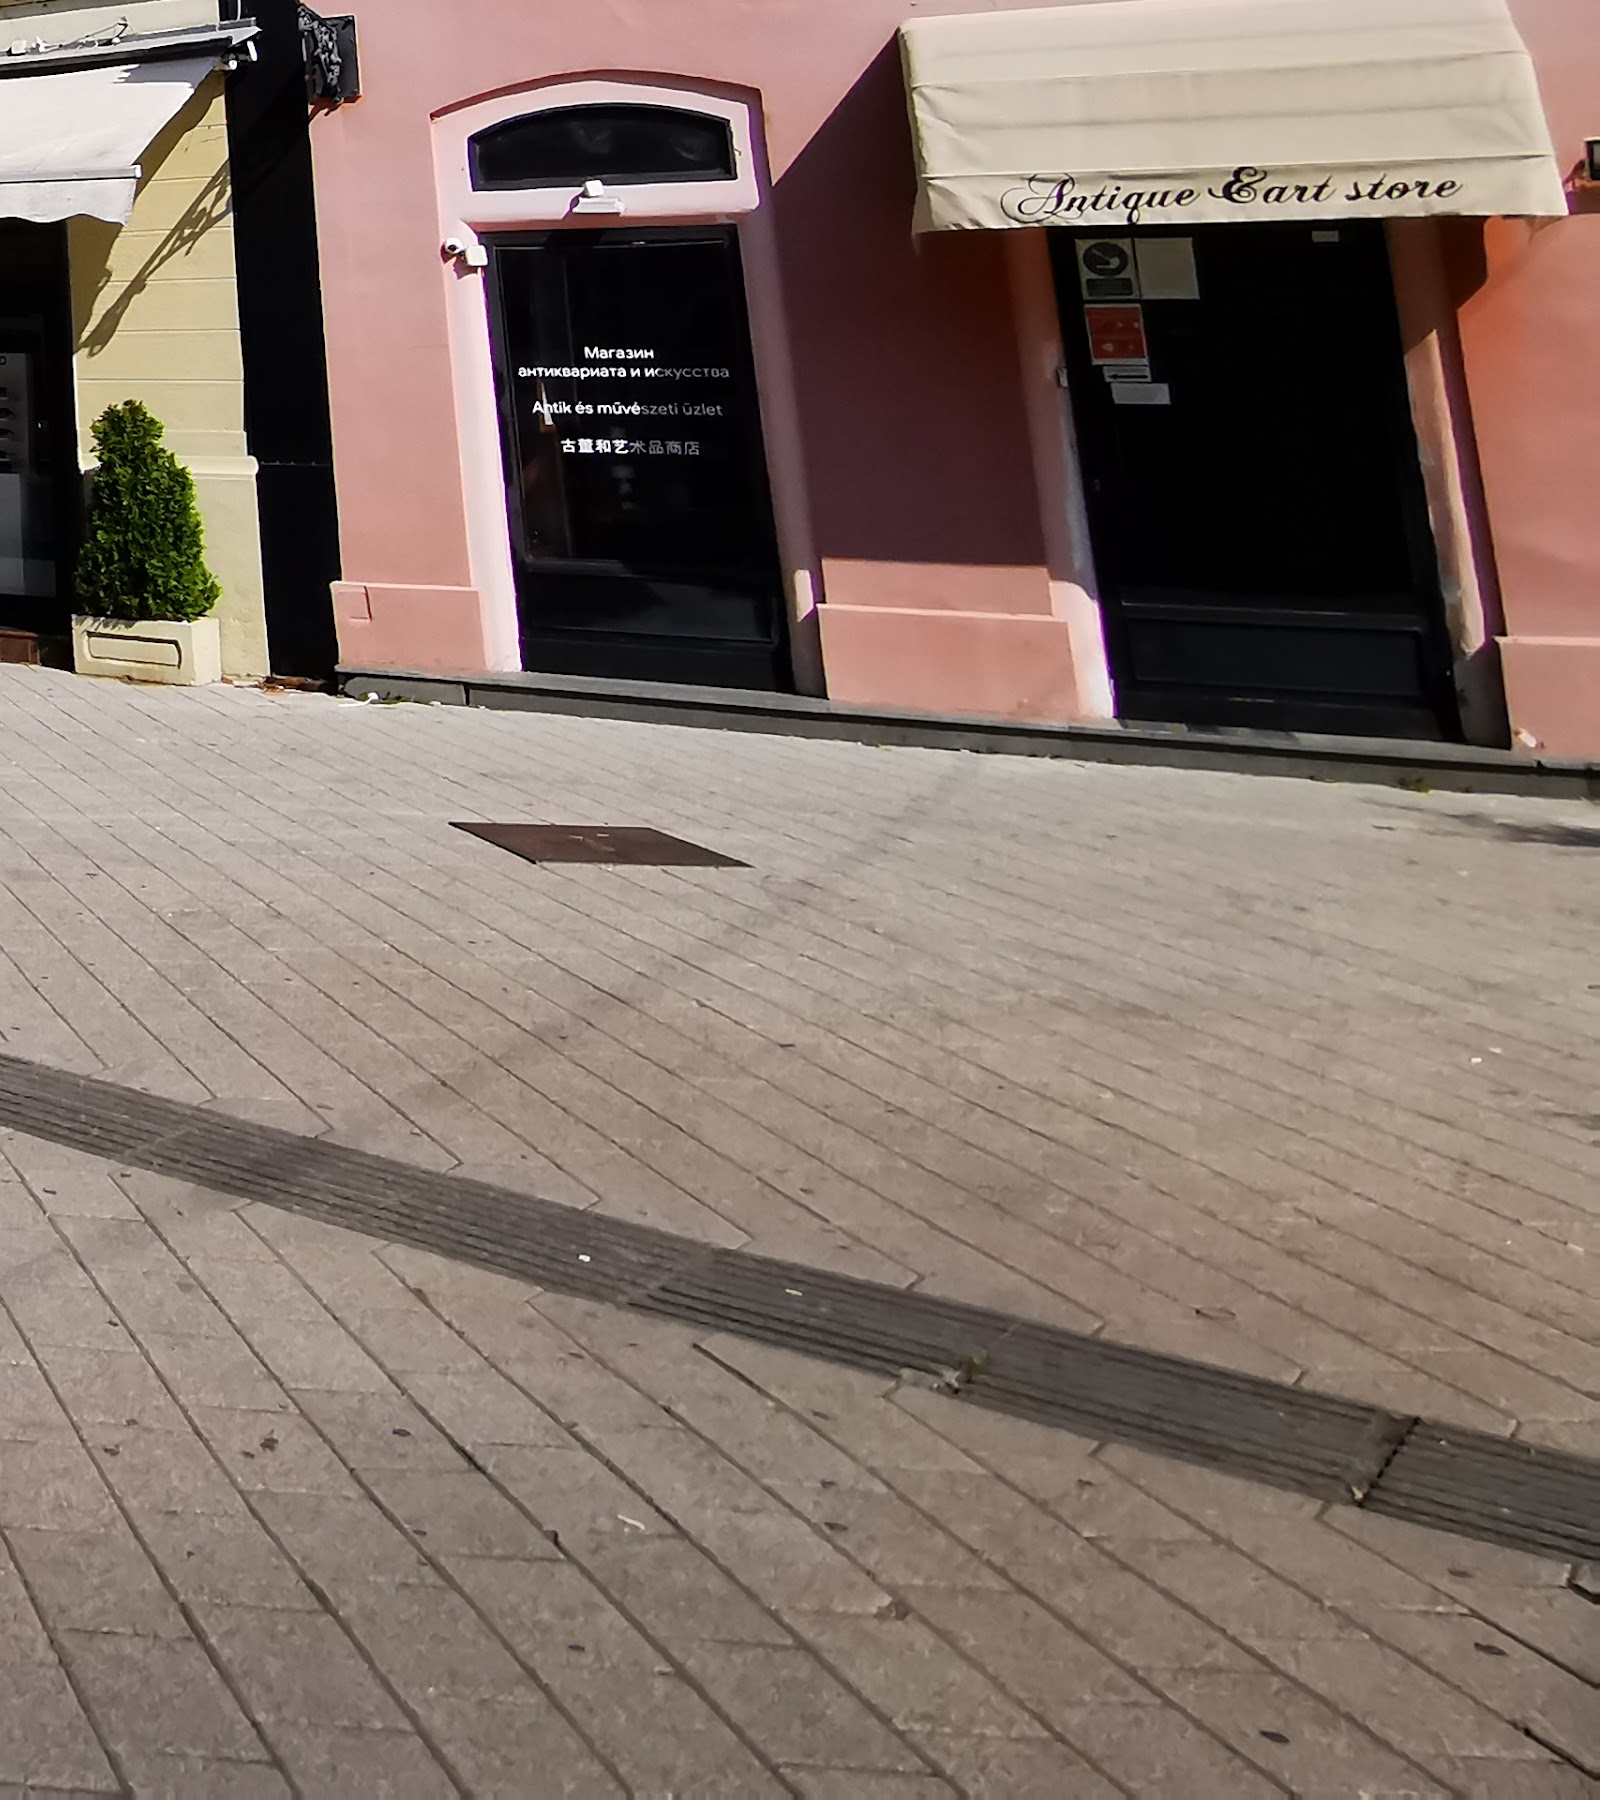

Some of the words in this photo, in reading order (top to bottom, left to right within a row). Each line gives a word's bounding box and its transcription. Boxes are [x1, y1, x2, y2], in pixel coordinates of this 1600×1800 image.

[1000, 172, 1200, 225] Antique
[1263, 174, 1338, 205] art
[1344, 172, 1463, 201] store
[583, 346, 654, 360] Магазин
[517, 367, 627, 381] антиквариата
[630, 367, 641, 378] и
[644, 367, 730, 381] искусства
[532, 401, 573, 415] Antik
[574, 401, 594, 415] és
